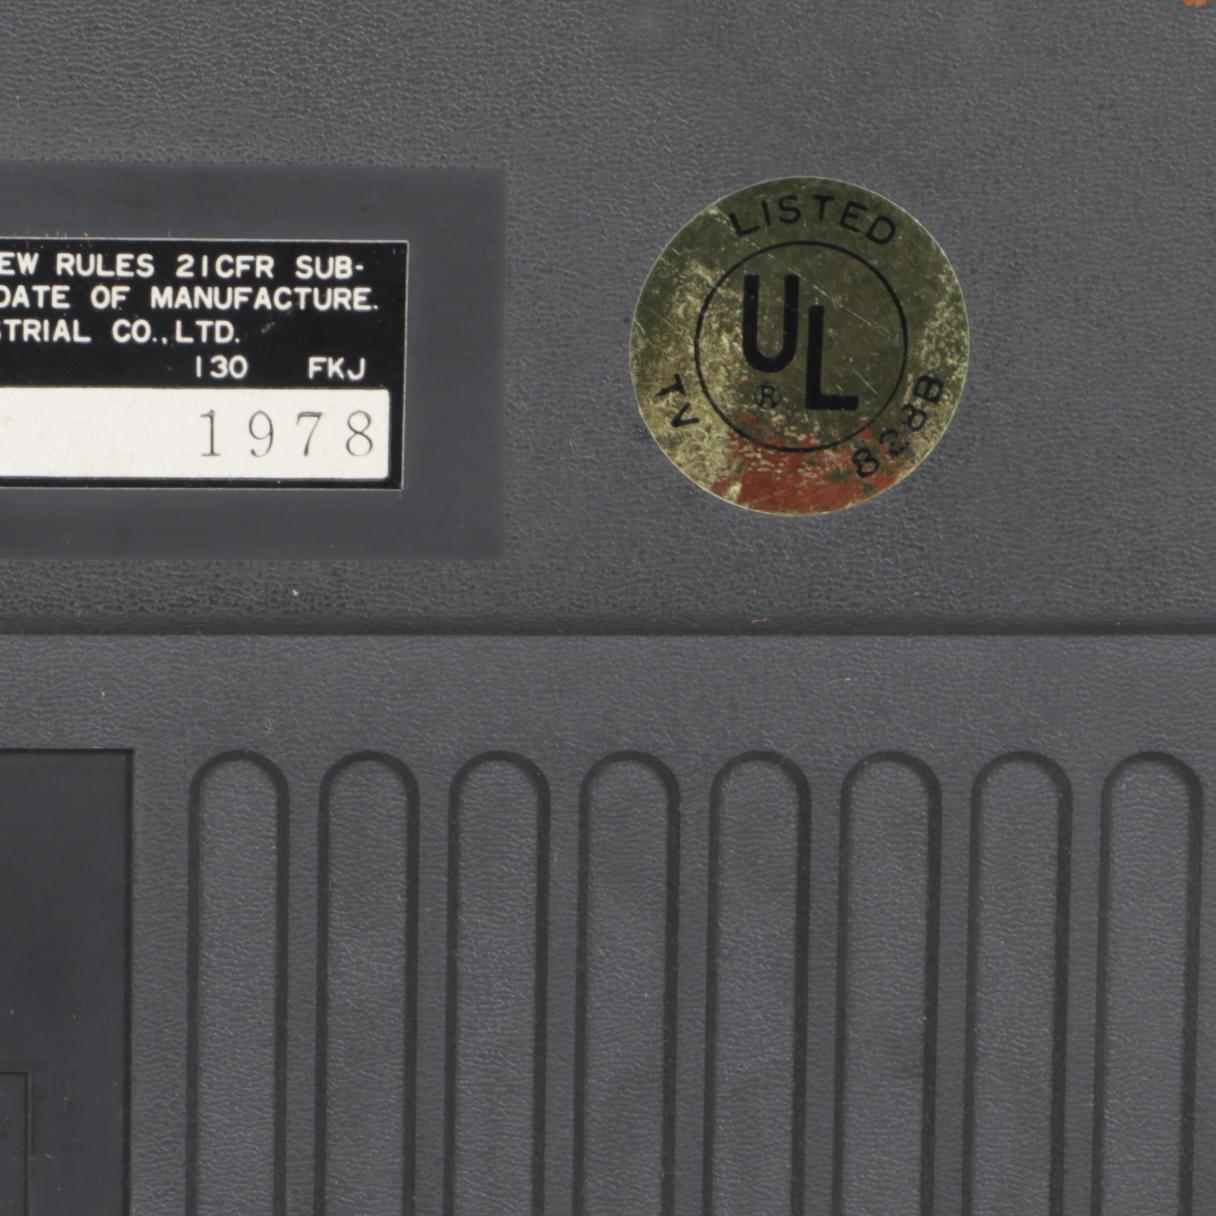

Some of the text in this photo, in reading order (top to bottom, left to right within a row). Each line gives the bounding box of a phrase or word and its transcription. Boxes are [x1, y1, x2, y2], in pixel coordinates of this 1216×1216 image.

[729, 194, 897, 245] LISTED
[56, 253, 154, 277] RULES
[175, 254, 274, 278] 21CFR
[295, 255, 364, 279] SUB-
[90, 286, 130, 309] OF
[150, 287, 379, 311] MANUFACTURE.
[742, 274, 859, 411] UL
[195, 355, 248, 379] 130
[308, 356, 366, 381] FKJ
[199, 409, 374, 458] 1978
